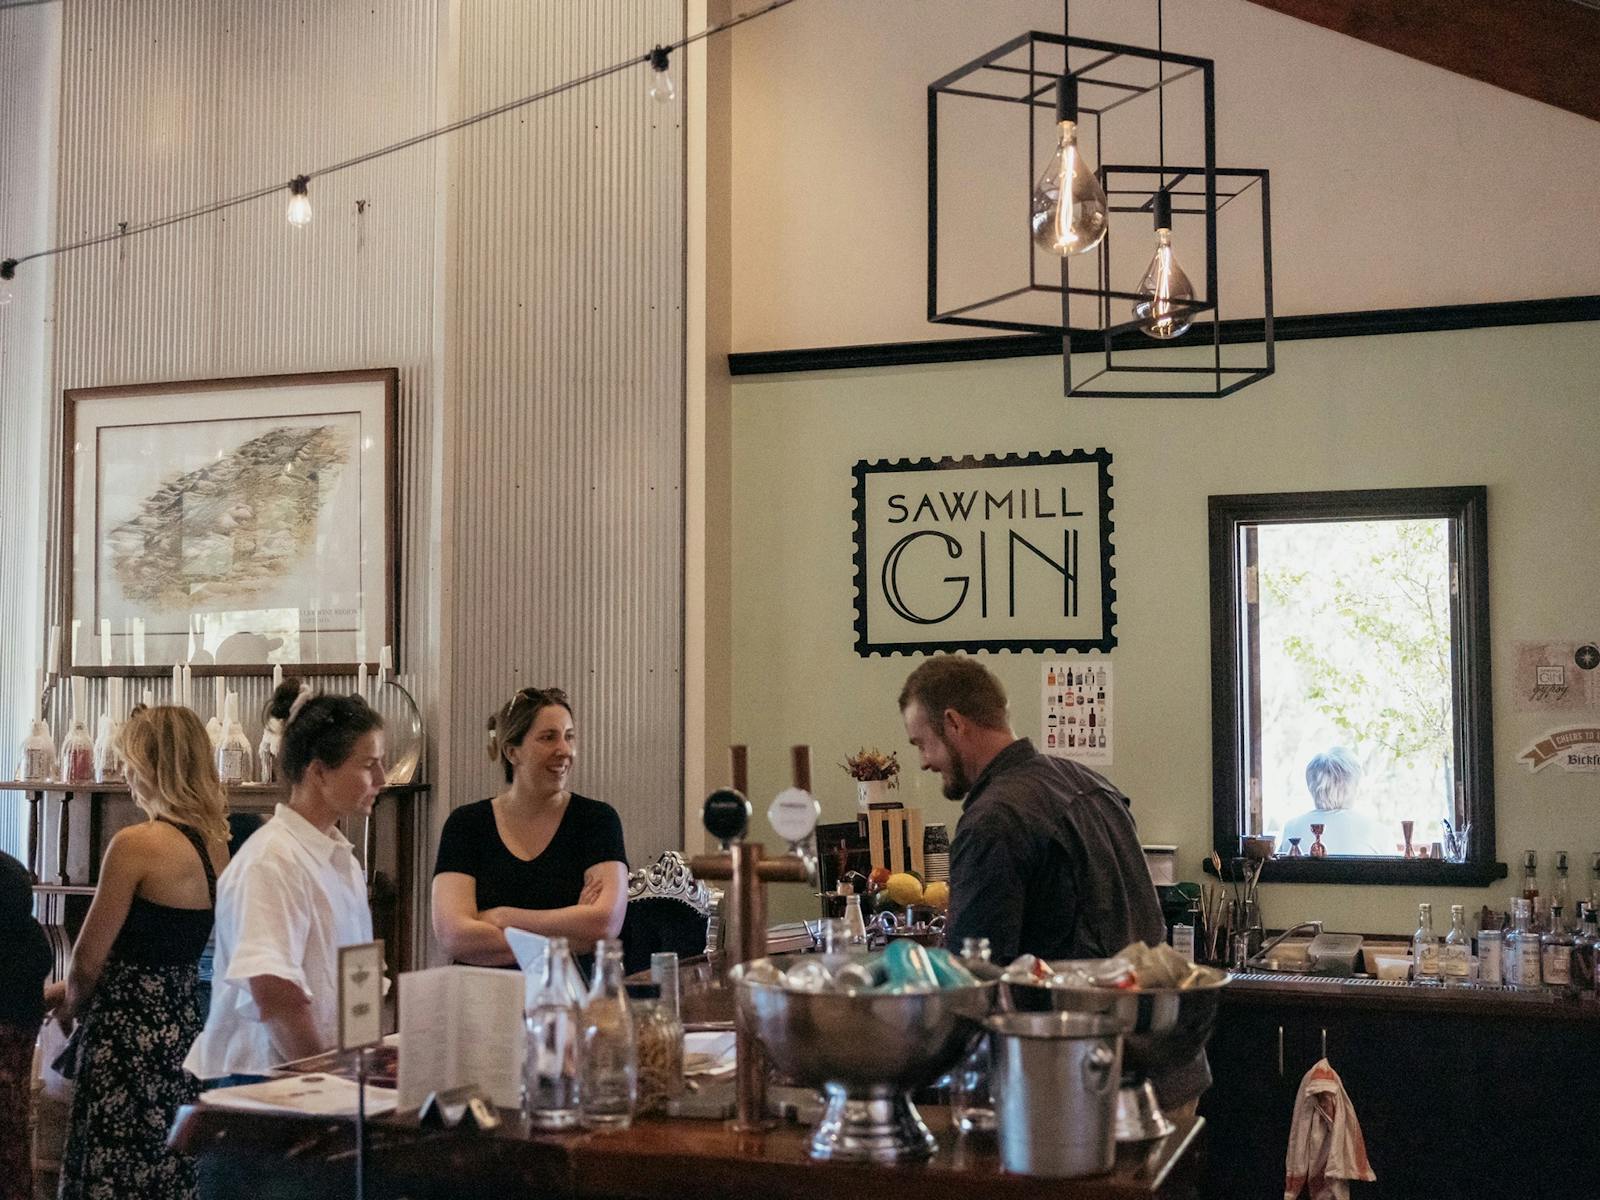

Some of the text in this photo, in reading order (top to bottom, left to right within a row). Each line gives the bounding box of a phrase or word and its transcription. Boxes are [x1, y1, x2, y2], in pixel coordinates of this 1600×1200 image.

[887, 487, 1084, 524] SAWMILL
[881, 529, 1079, 625] GIN
[1556, 732, 1583, 745] CHEERS
